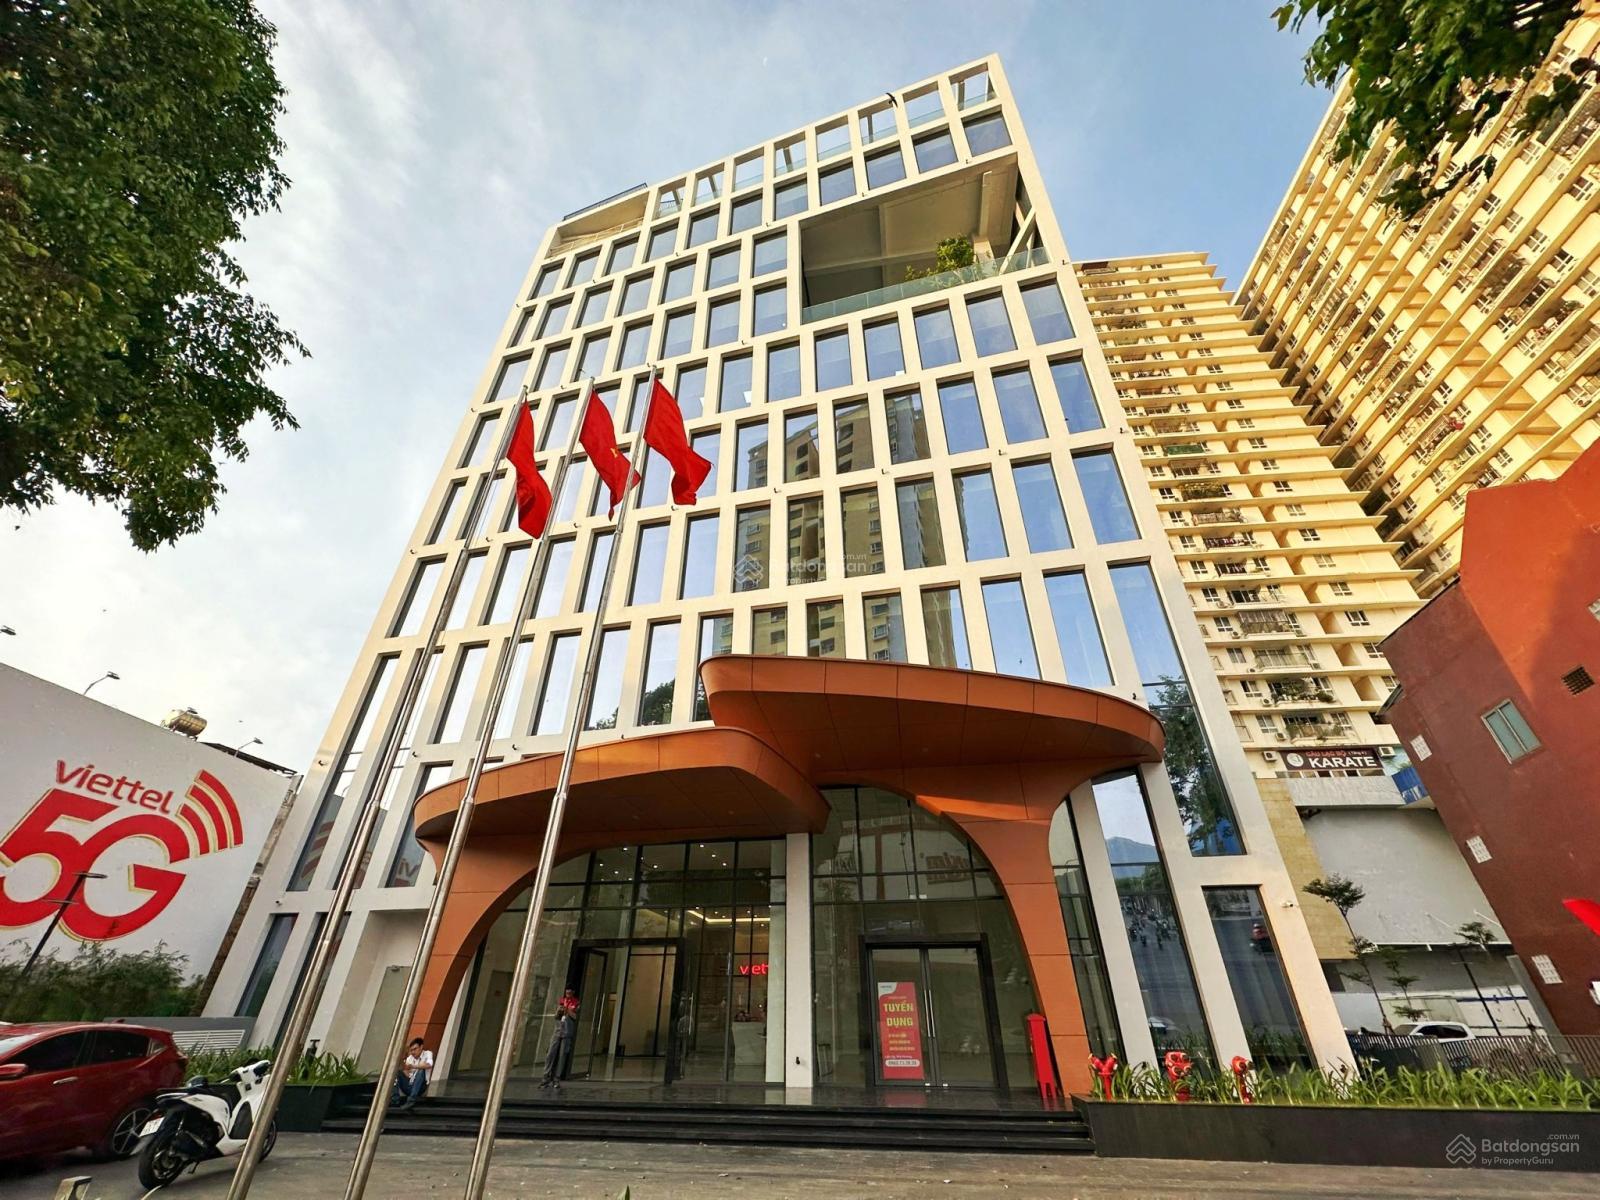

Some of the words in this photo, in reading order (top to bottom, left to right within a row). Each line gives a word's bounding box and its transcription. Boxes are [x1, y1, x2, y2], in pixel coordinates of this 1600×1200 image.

[1308, 756, 1377, 768] KARATE
[56, 759, 174, 814] viettel
[0, 788, 189, 942] 5G
[886, 1017, 913, 1028] DỤNG
